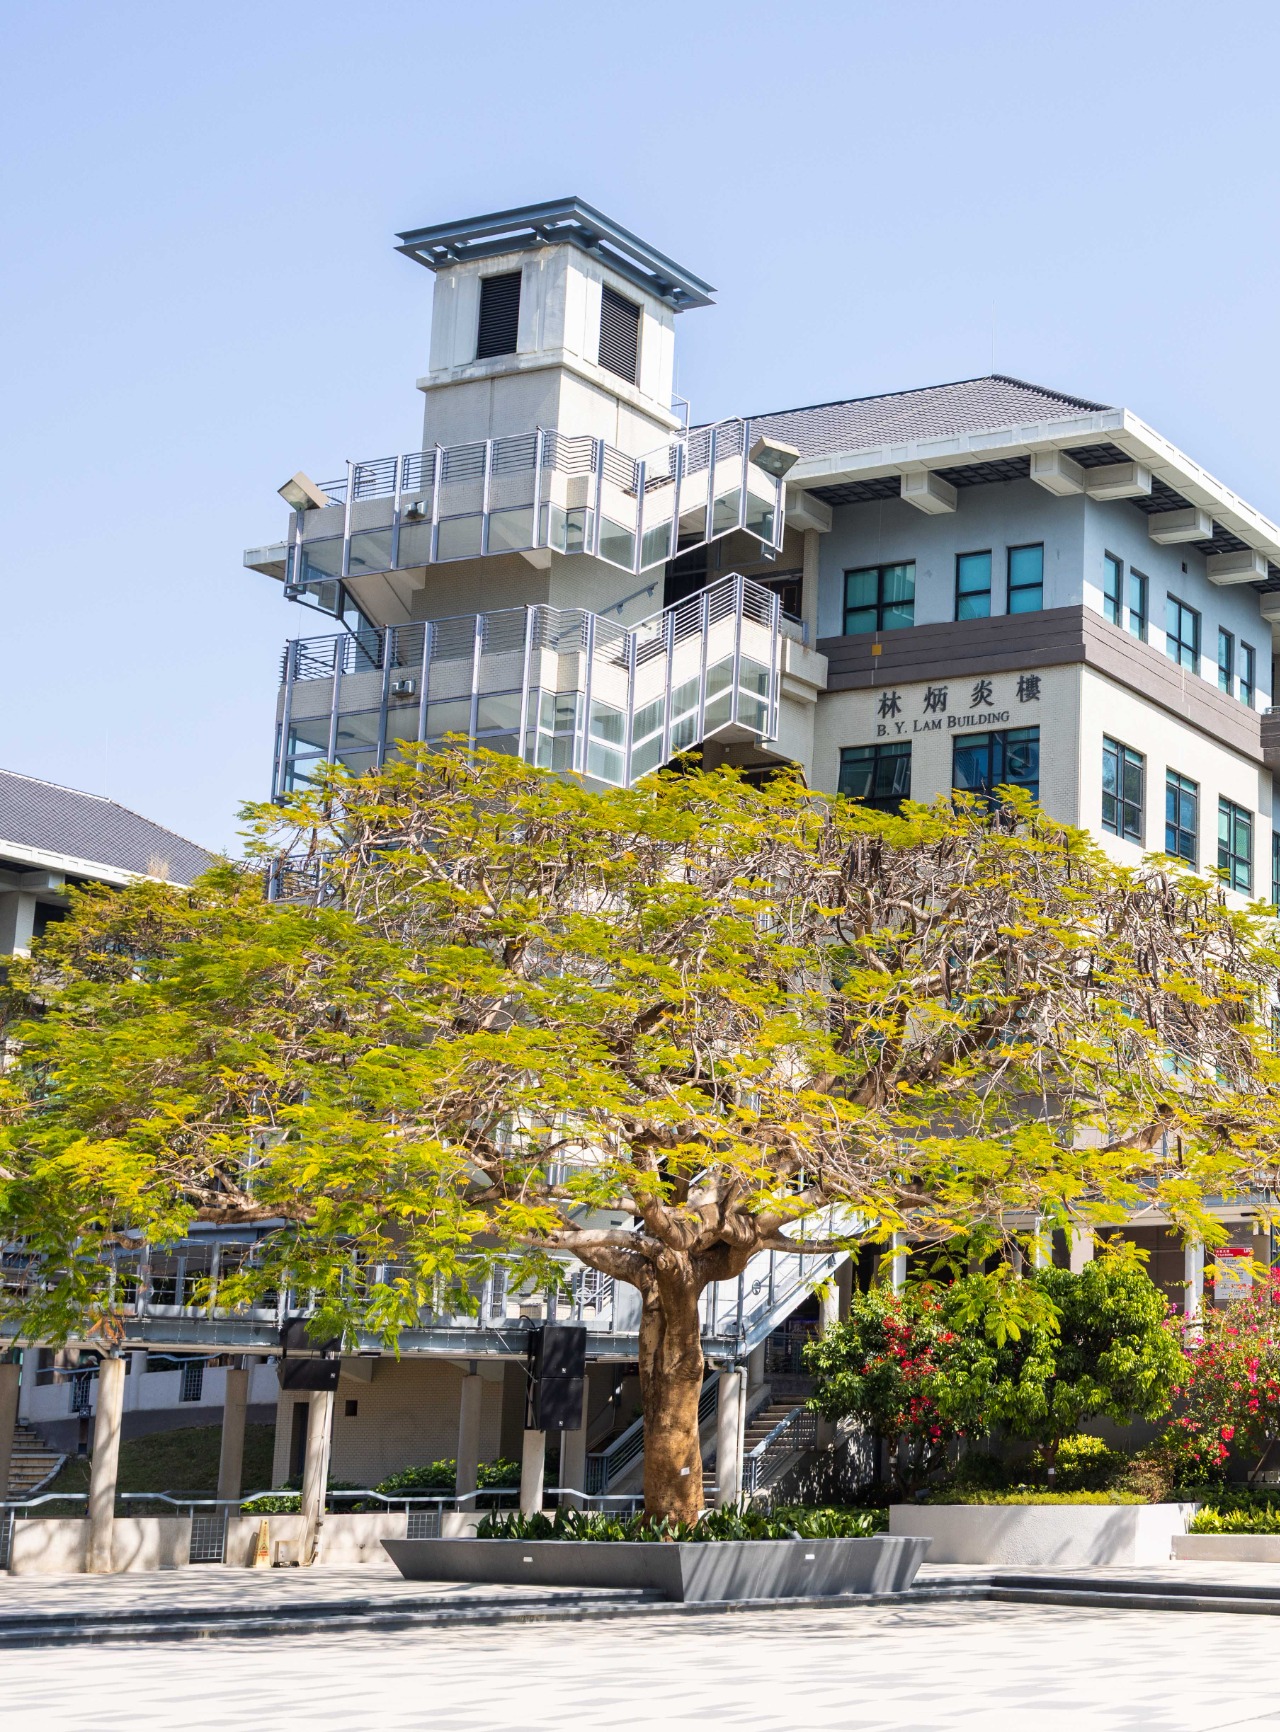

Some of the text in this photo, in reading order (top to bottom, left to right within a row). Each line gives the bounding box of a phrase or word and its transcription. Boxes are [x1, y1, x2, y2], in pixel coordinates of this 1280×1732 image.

[877, 674, 1042, 719] 林炳炎樓
[877, 724, 890, 737] B.
[895, 721, 908, 734] Y.
